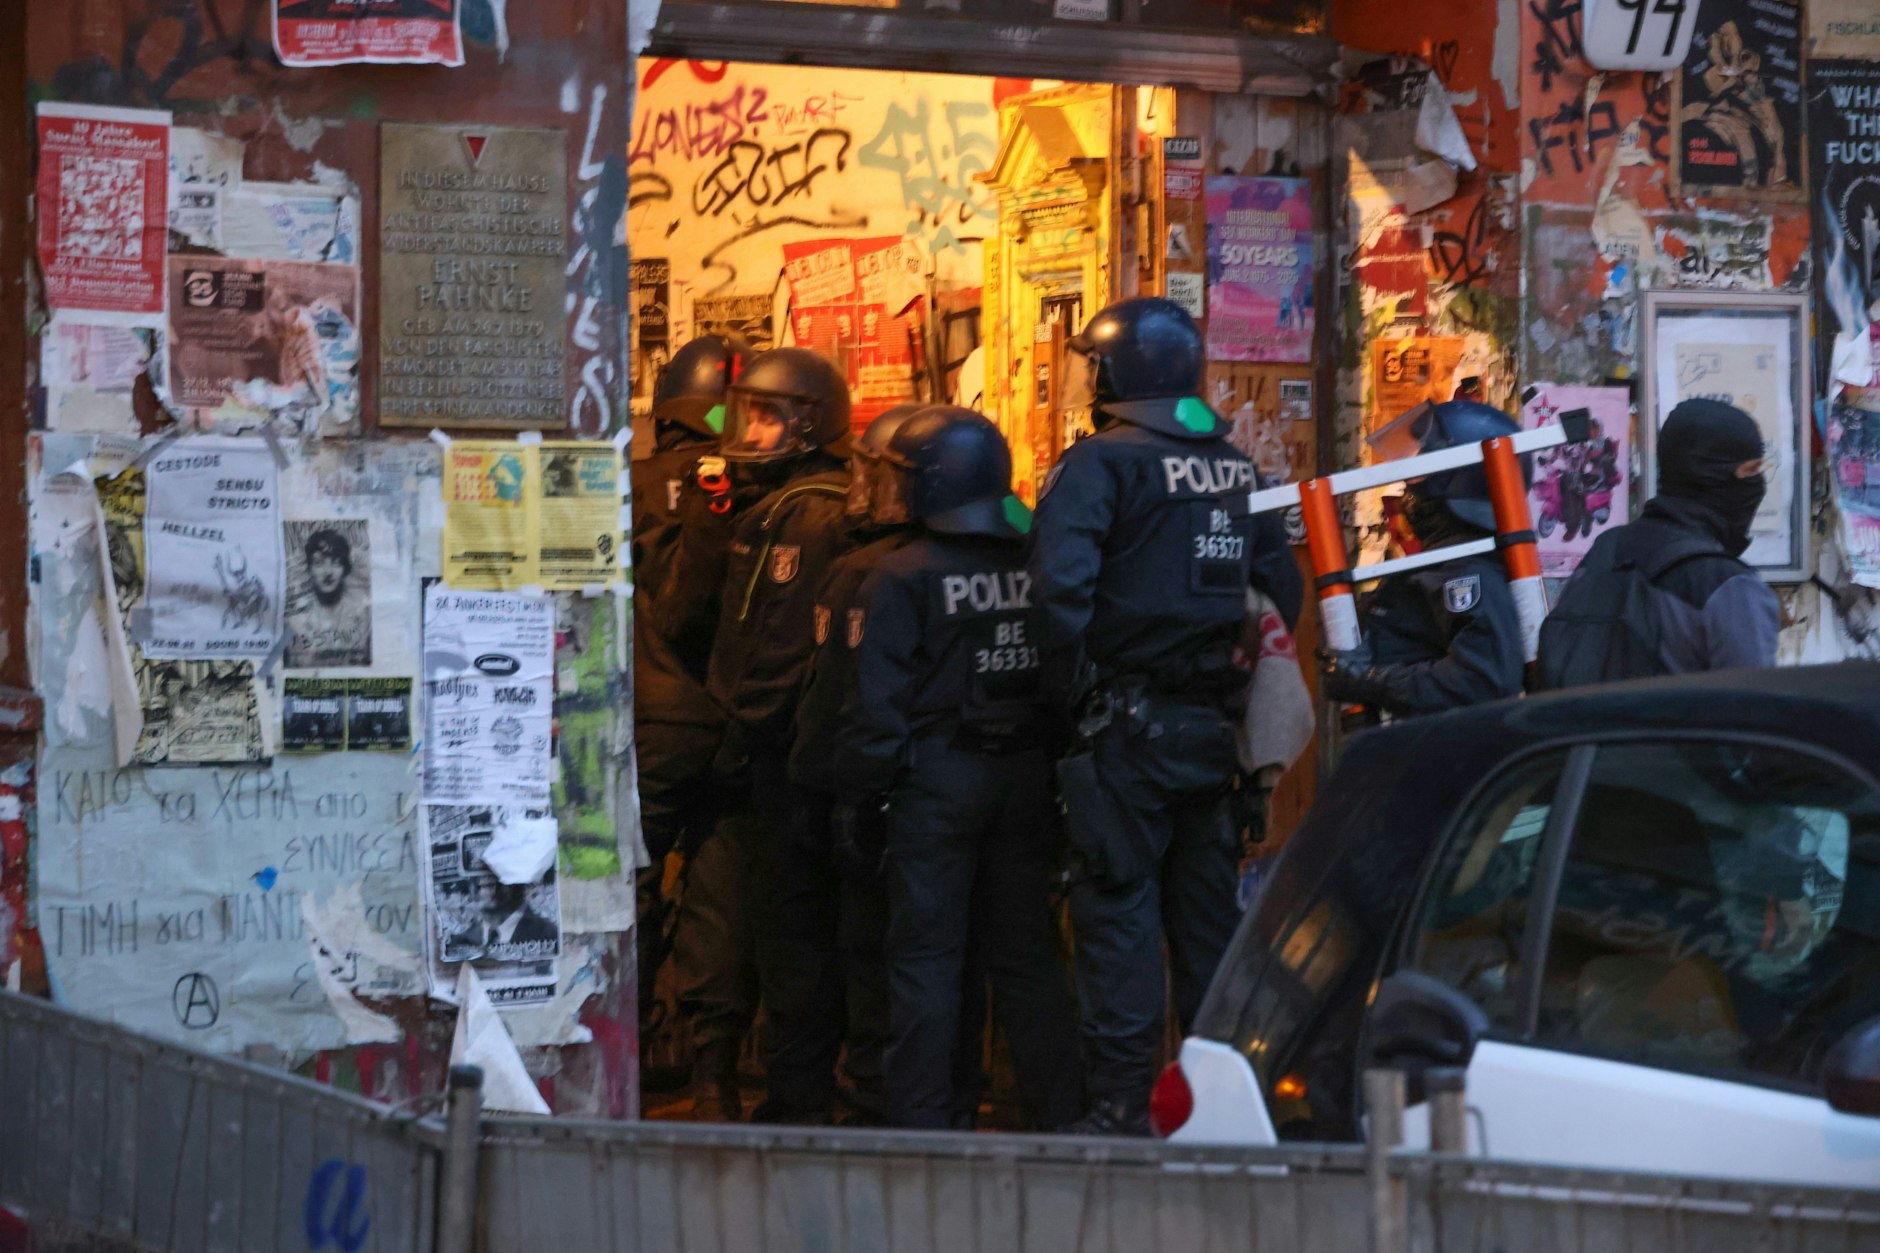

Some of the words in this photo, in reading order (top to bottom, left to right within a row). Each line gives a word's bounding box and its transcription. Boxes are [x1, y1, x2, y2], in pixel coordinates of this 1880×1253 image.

[424, 172, 486, 191] DIESEM
[491, 174, 551, 193] HAUSE
[415, 193, 492, 212] WOHNTE
[500, 196, 532, 214] DER
[1226, 208, 1291, 226] INTERNATIONAL
[432, 258, 518, 283] ERNST
[417, 284, 533, 312] PAHNKE
[384, 338, 421, 356] VON
[426, 339, 460, 357] DEN
[154, 454, 222, 473] CESTODE
[215, 478, 265, 492] SENSU
[207, 496, 272, 510] STRICTO
[161, 521, 226, 543] HELLZEL
[1193, 534, 1245, 560] 36327
[995, 620, 1026, 647] BE
[976, 646, 1040, 673] 36331
